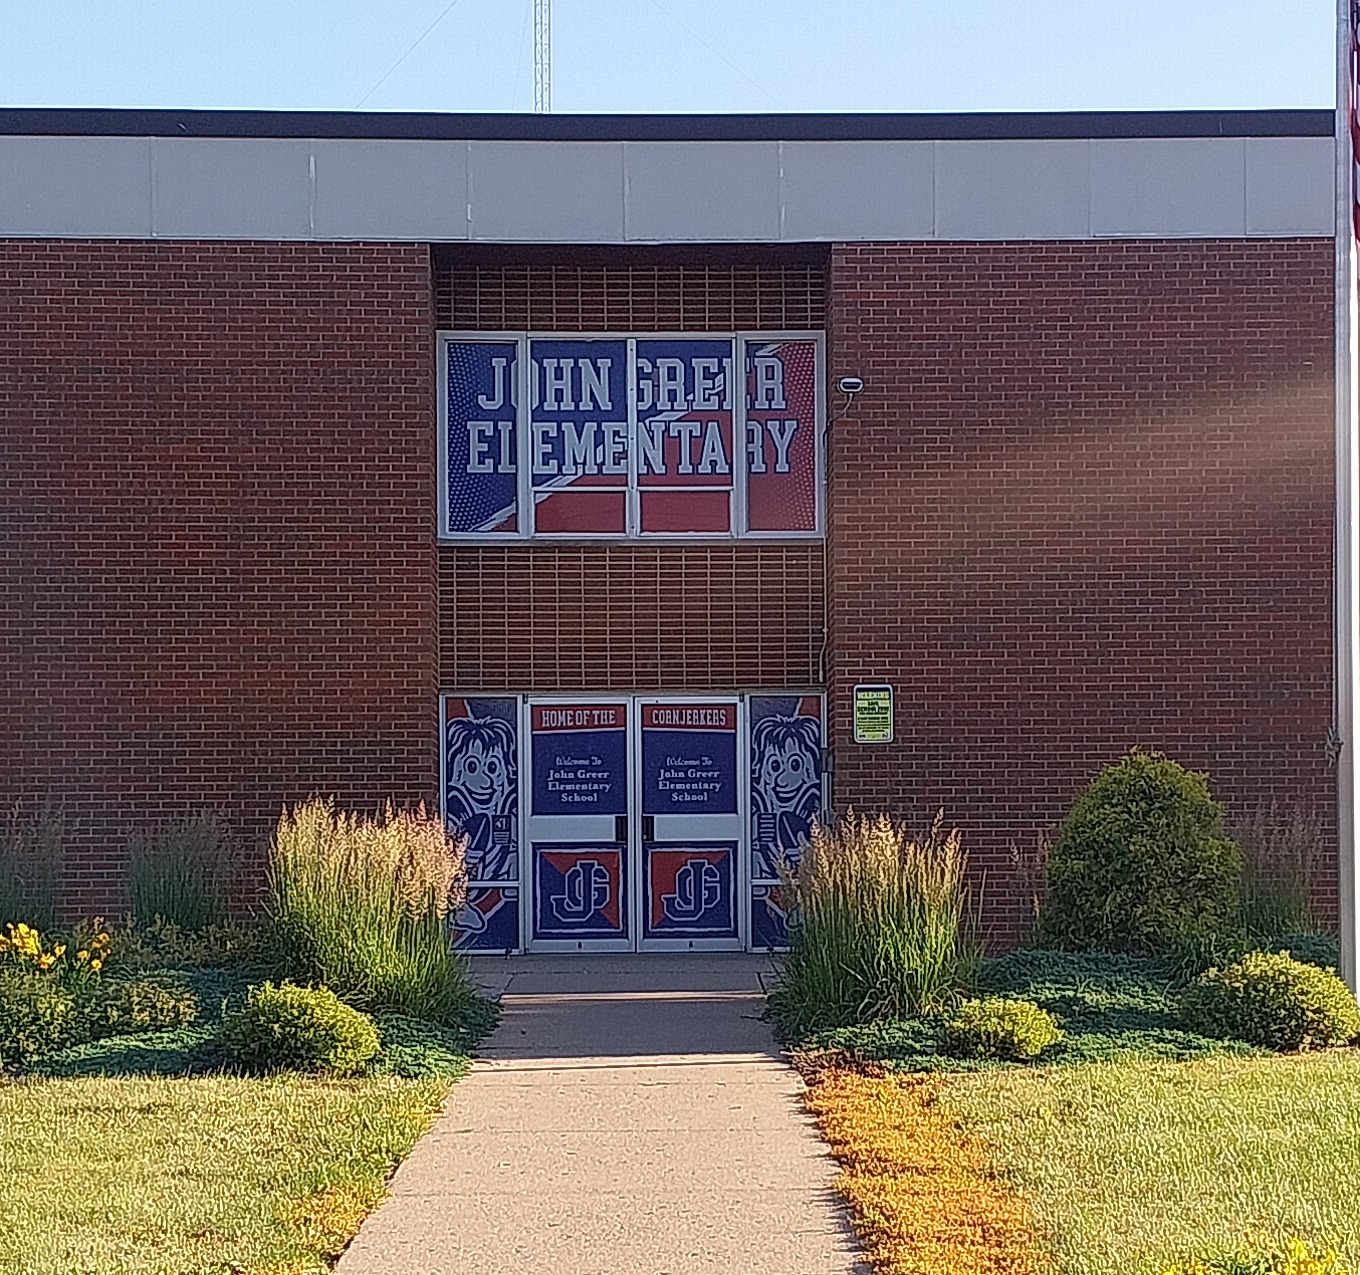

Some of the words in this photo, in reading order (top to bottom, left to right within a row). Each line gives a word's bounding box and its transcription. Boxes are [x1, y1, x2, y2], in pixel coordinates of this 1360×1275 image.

[467, 420, 798, 474] ELEMENTARY
[541, 710, 574, 727] HOME
[575, 710, 590, 726] OF
[592, 709, 616, 725] THE
[652, 709, 726, 726] CORNJERKERS
[556, 756, 590, 765] Welcome
[666, 756, 700, 765] Welcome
[547, 769, 575, 780] John
[577, 769, 610, 779] Greer
[658, 769, 685, 780] John
[687, 769, 720, 778] Greer
[547, 781, 611, 792] Elementary
[658, 781, 721, 792] Elementary
[561, 793, 598, 802] School
[671, 792, 708, 801] School
